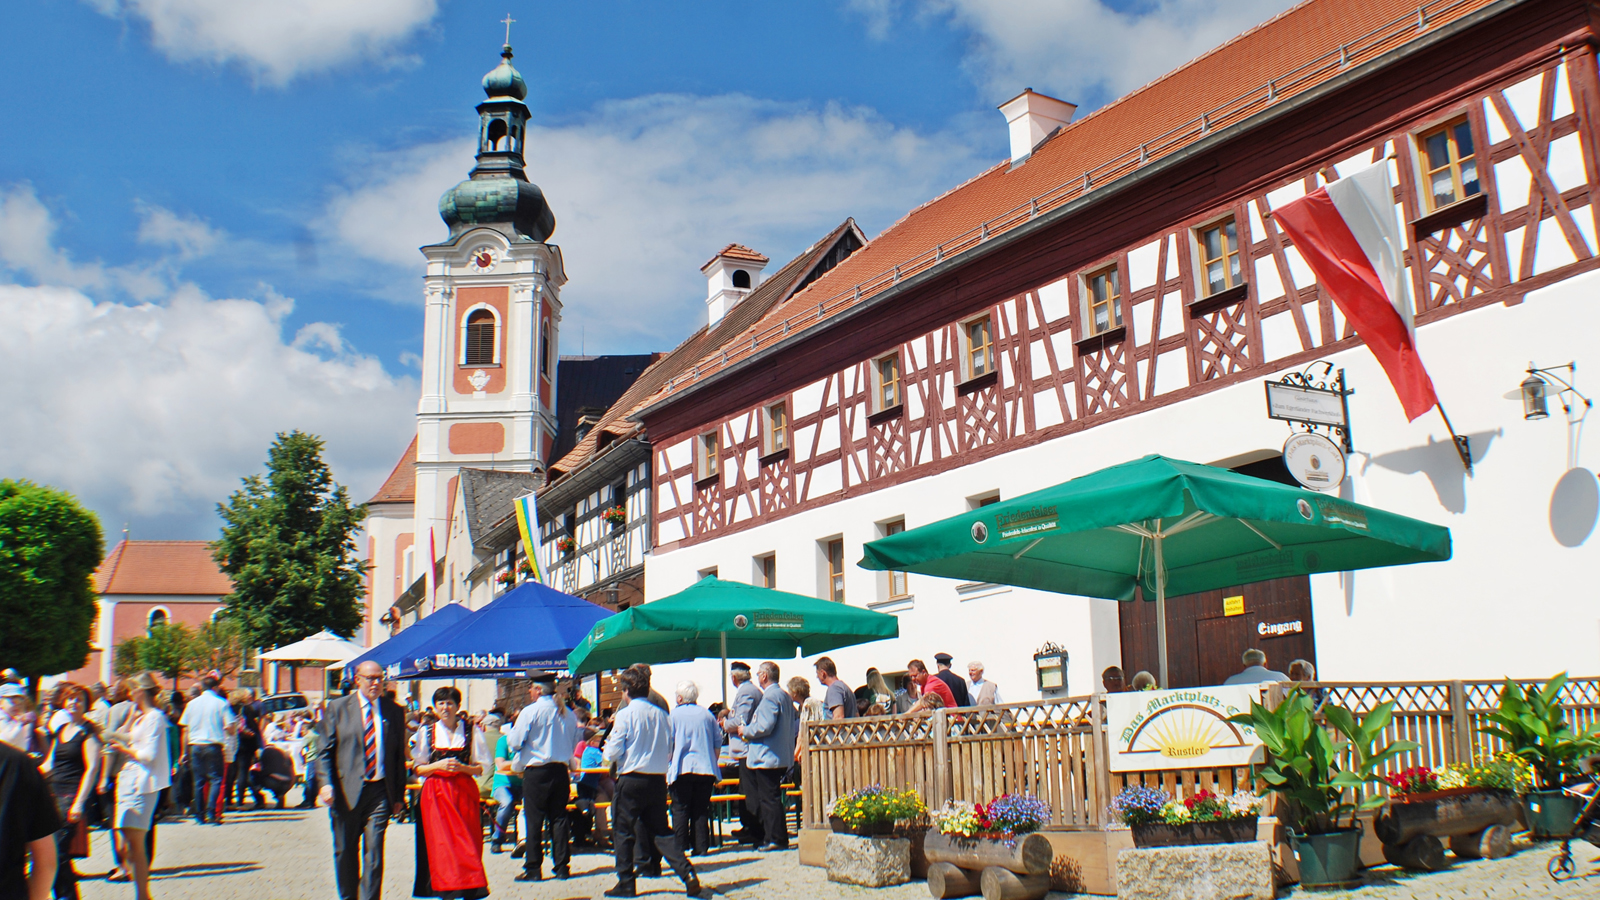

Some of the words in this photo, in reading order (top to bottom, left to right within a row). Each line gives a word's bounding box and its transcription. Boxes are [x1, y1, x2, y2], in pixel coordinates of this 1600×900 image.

[995, 504, 1058, 529] Friedenfelser
[752, 611, 804, 621] Friedenfelser
[1257, 620, 1303, 635] Eingang
[435, 652, 510, 669] Mönchshof
[1119, 711, 1145, 744] Das
